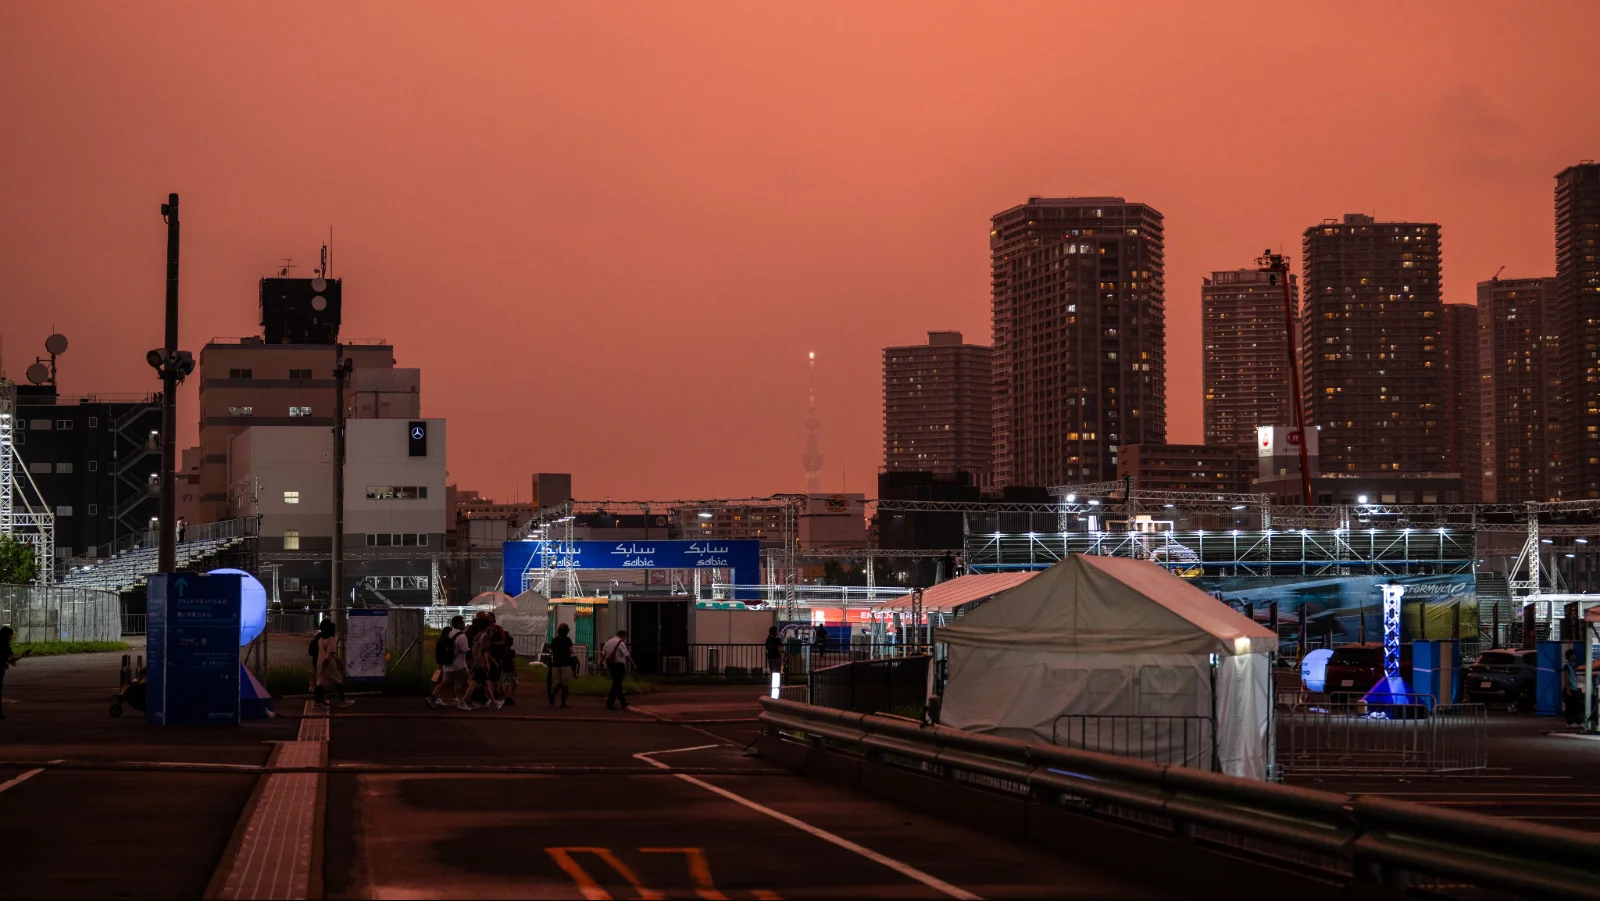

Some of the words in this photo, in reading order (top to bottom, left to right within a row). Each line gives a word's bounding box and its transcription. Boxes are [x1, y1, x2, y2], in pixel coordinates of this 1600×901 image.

[622, 555, 655, 567] sabic
[696, 555, 729, 566] sabic
[1408, 583, 1453, 594] FORMULA
